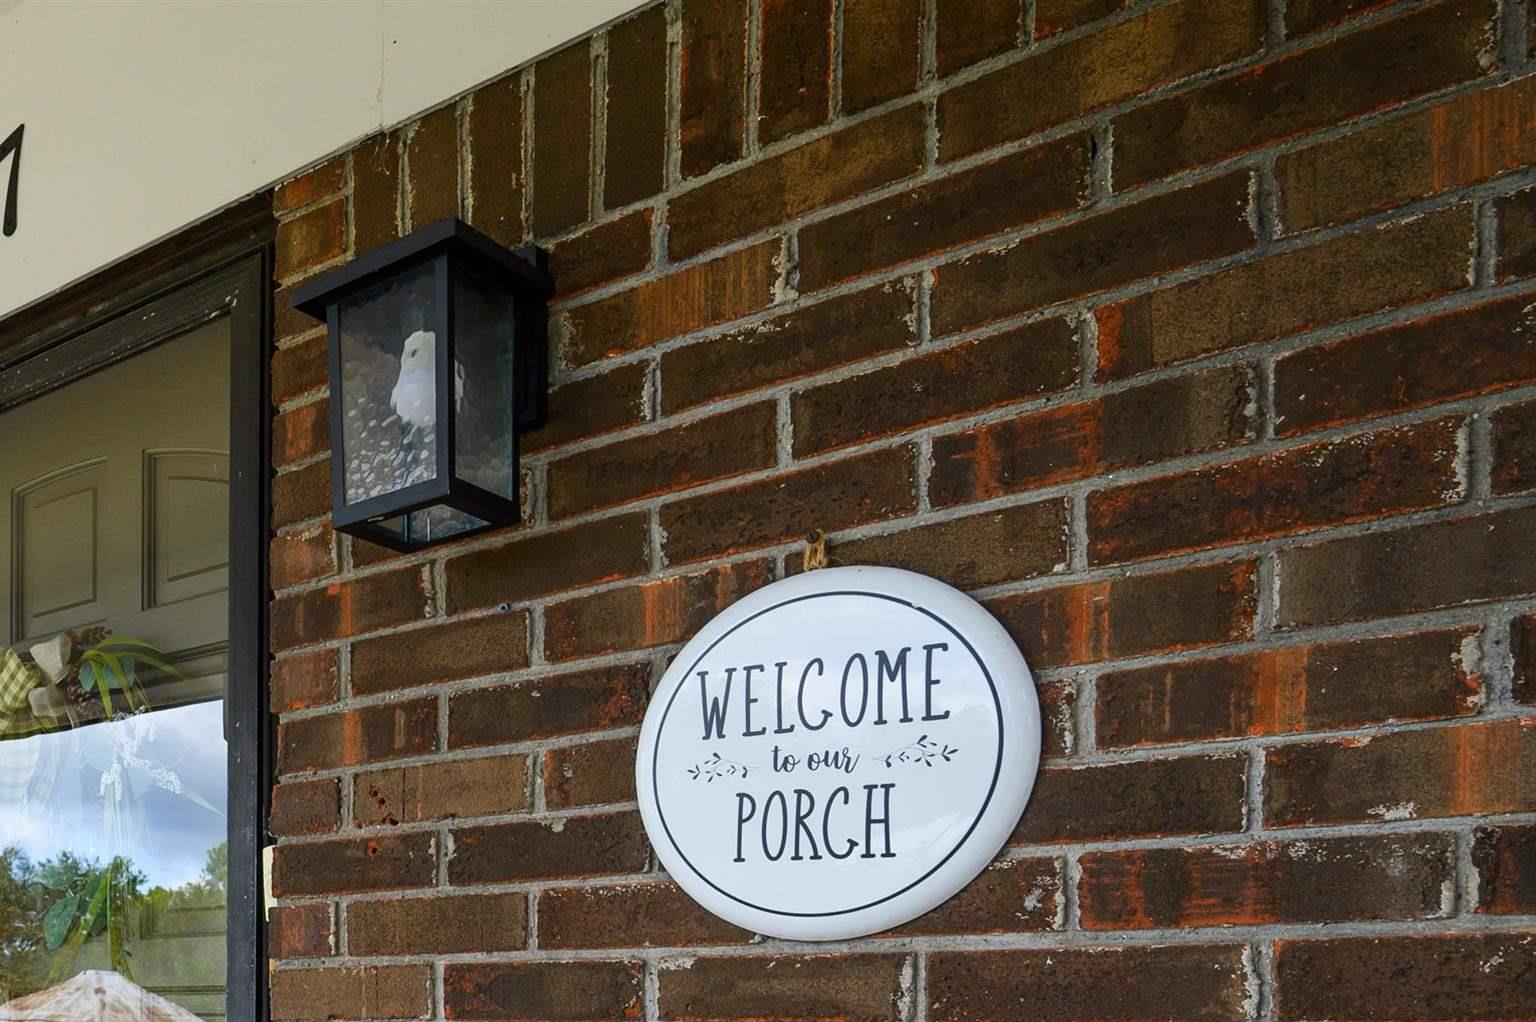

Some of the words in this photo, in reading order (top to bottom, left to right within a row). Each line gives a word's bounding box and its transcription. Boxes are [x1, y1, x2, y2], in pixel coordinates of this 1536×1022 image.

[696, 642, 951, 740] WELCOME
[771, 745, 801, 773] to
[807, 745, 860, 774] our
[732, 783, 897, 862] PORCH
